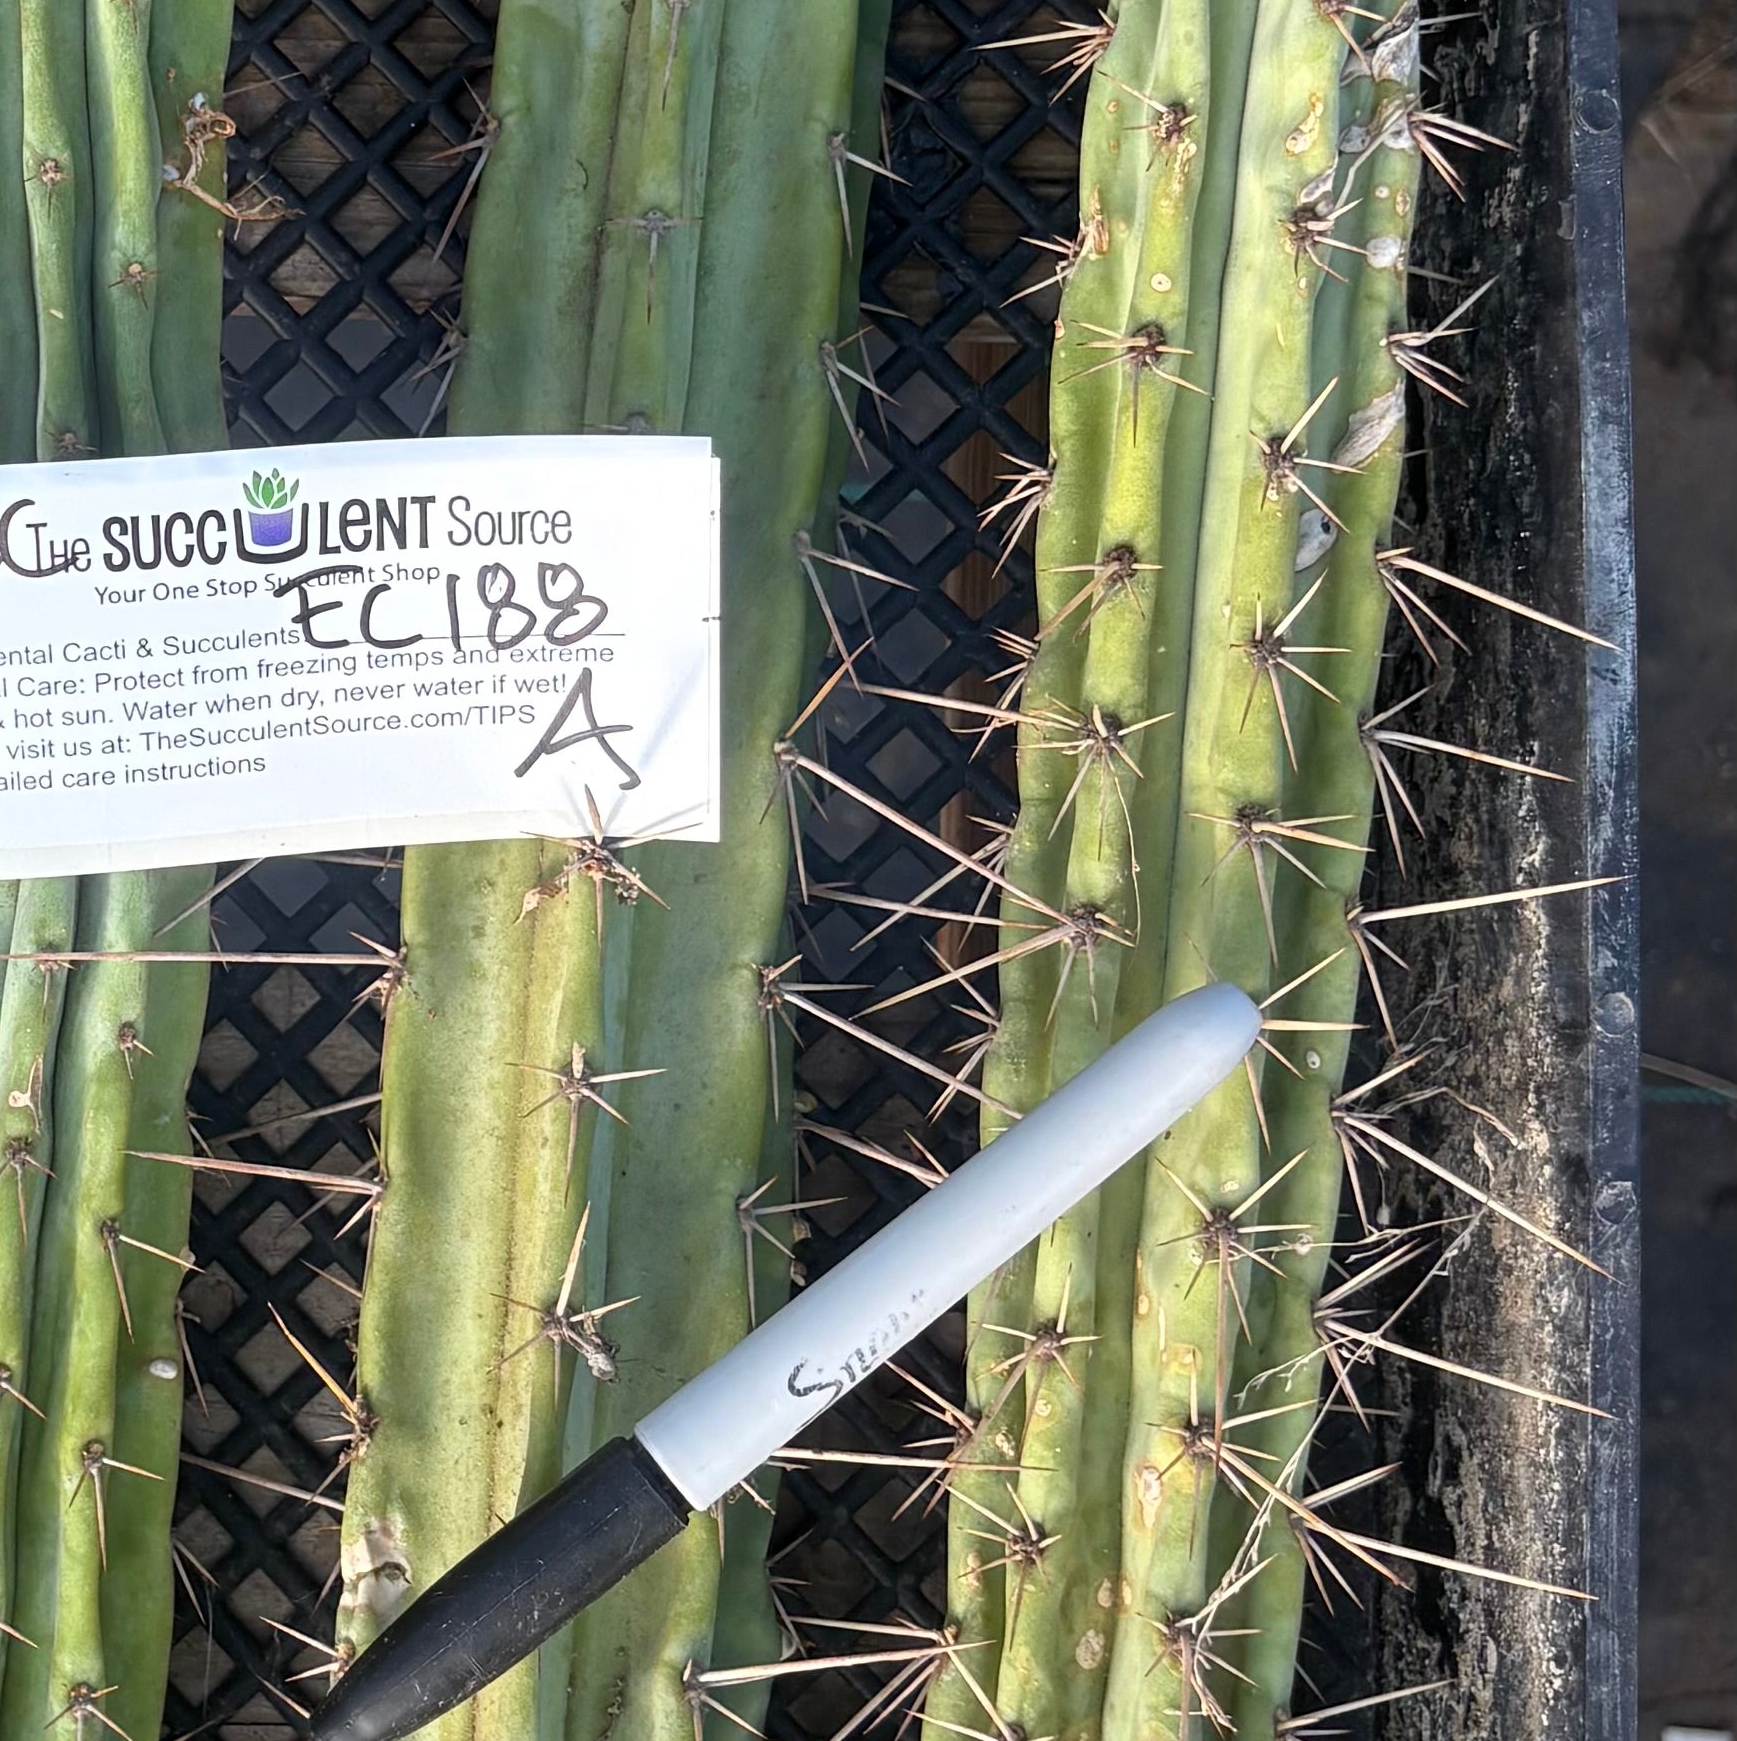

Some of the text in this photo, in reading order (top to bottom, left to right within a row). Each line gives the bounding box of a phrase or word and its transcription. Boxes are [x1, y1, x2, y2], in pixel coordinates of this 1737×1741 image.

[448, 495, 572, 546] Source
[95, 586, 146, 605] Your
[153, 582, 199, 601] One
[207, 577, 257, 599] Stop
[382, 563, 440, 585] Shop
[273, 562, 608, 651] EC188
[63, 639, 126, 664] Cacti
[136, 637, 154, 658] &
[163, 627, 299, 656] Succulents
[17, 676, 86, 697] Care:
[95, 668, 184, 694] Protect
[193, 666, 248, 684] from
[257, 653, 356, 678] freezing
[367, 650, 443, 672] temps
[453, 648, 499, 664] and
[510, 647, 614, 664] extreme
[14, 707, 54, 727] hot
[61, 706, 114, 726] sun.
[123, 699, 197, 722] Water
[206, 693, 271, 715] when
[281, 686, 324, 709] dry,
[334, 682, 406, 702] never
[414, 676, 484, 697] water
[493, 674, 506, 695] if
[514, 674, 566, 694] wet!
[7, 738, 55, 759] visit
[63, 739, 92, 756] us
[101, 734, 131, 754] at:
[139, 705, 536, 752] TheSucculentSource.com/TIPS
[514, 667, 641, 790] A
[62, 767, 116, 787] care
[124, 754, 266, 784] instructions
